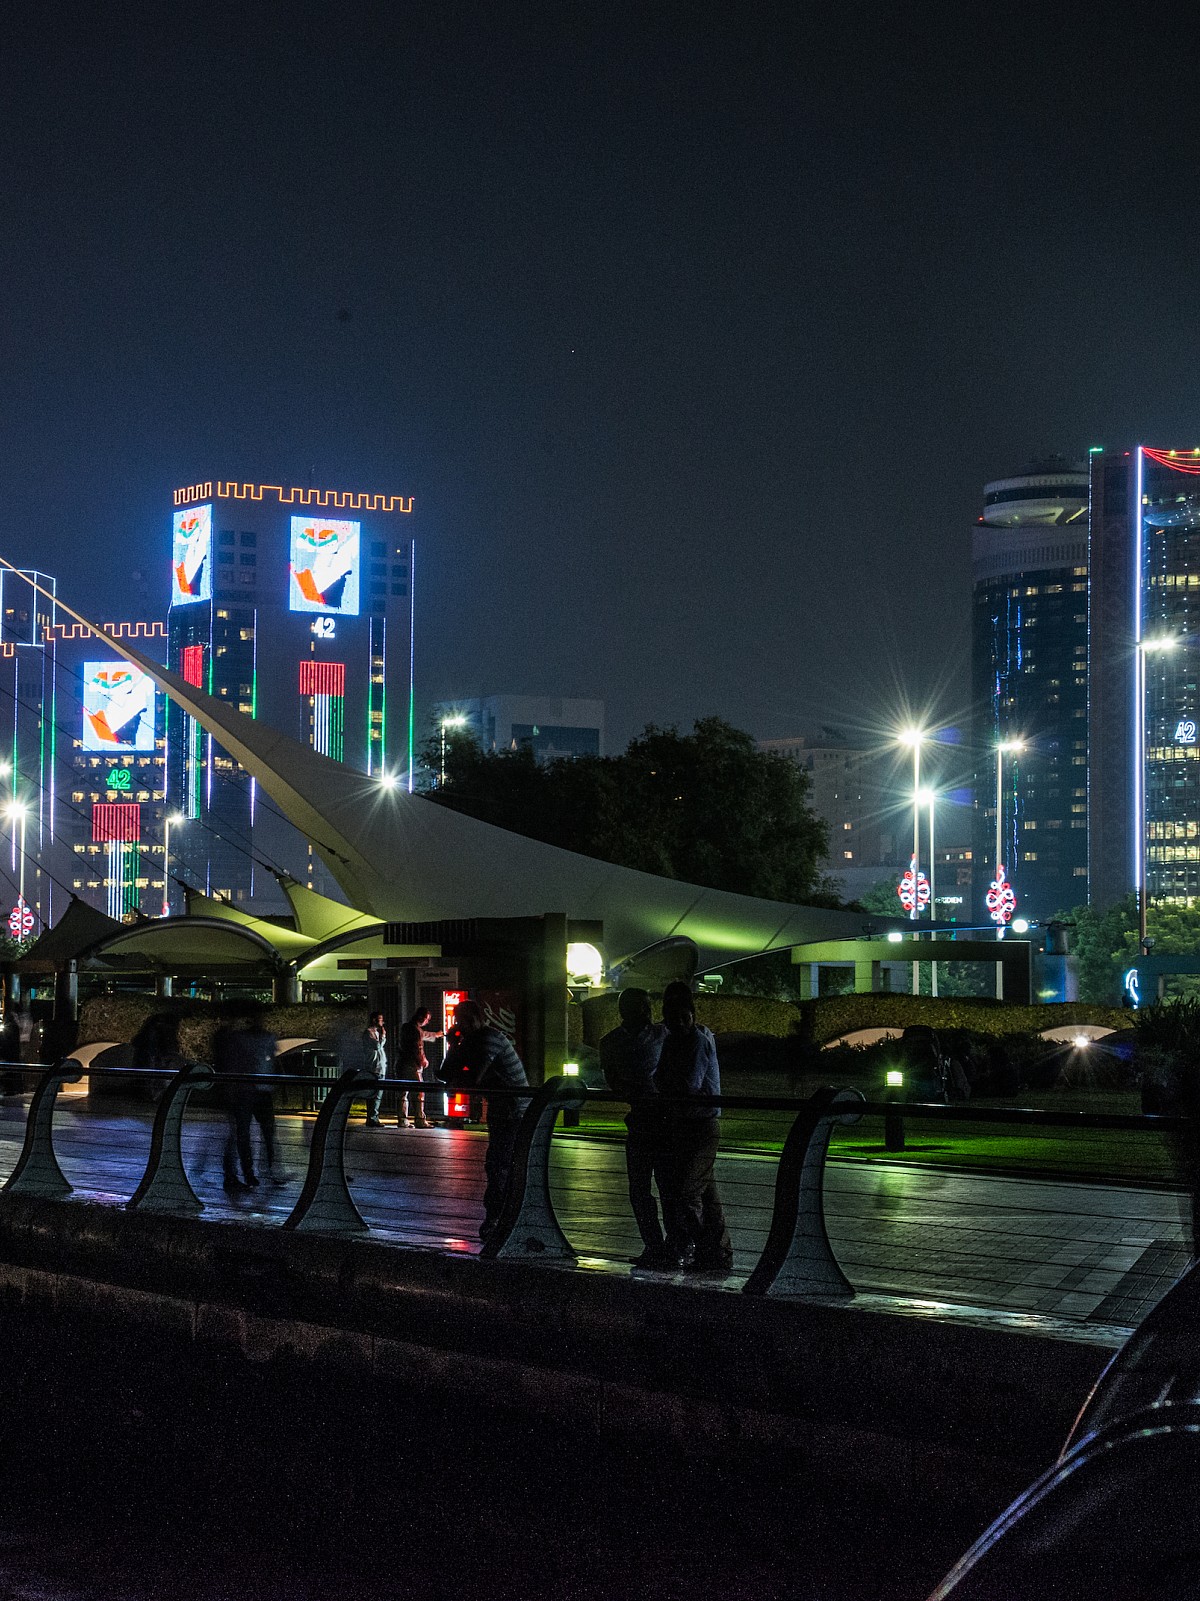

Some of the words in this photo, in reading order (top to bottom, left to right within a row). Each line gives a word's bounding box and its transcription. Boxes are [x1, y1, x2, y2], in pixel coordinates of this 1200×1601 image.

[313, 616, 336, 638] 42
[1175, 721, 1196, 743] 42
[107, 769, 130, 789] 42
